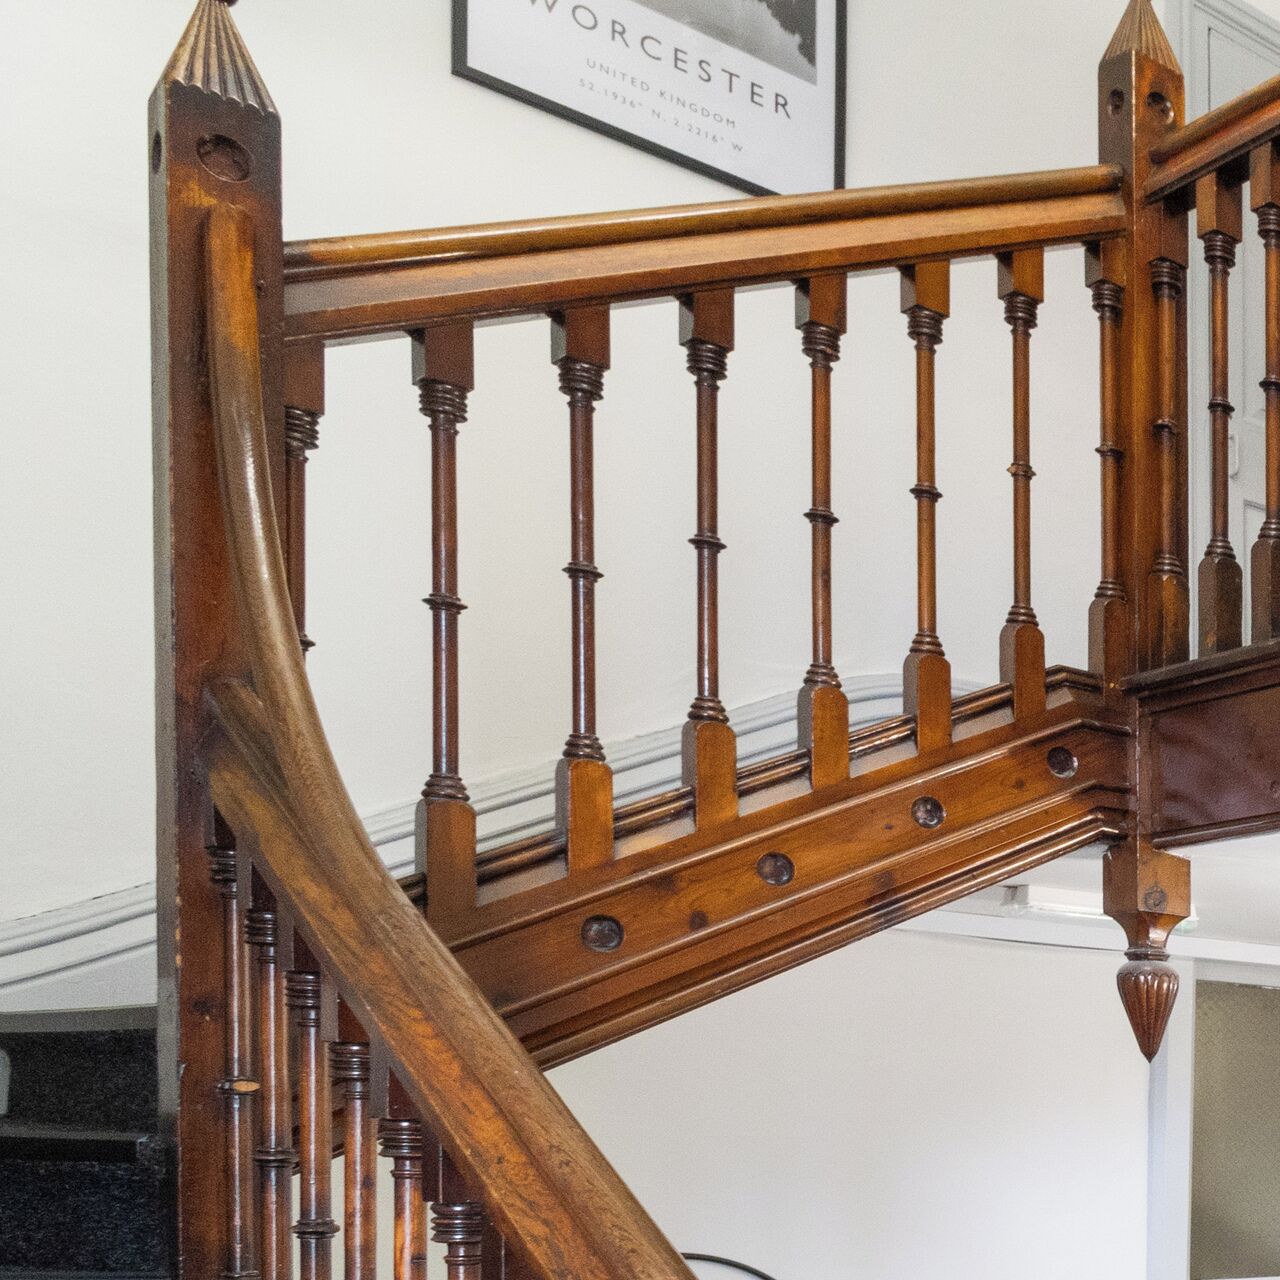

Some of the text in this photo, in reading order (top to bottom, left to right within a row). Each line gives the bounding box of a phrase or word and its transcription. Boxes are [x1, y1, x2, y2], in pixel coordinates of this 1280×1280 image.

[586, 58, 736, 129] UNITED KINGDOM
[731, 141, 744, 152] W
